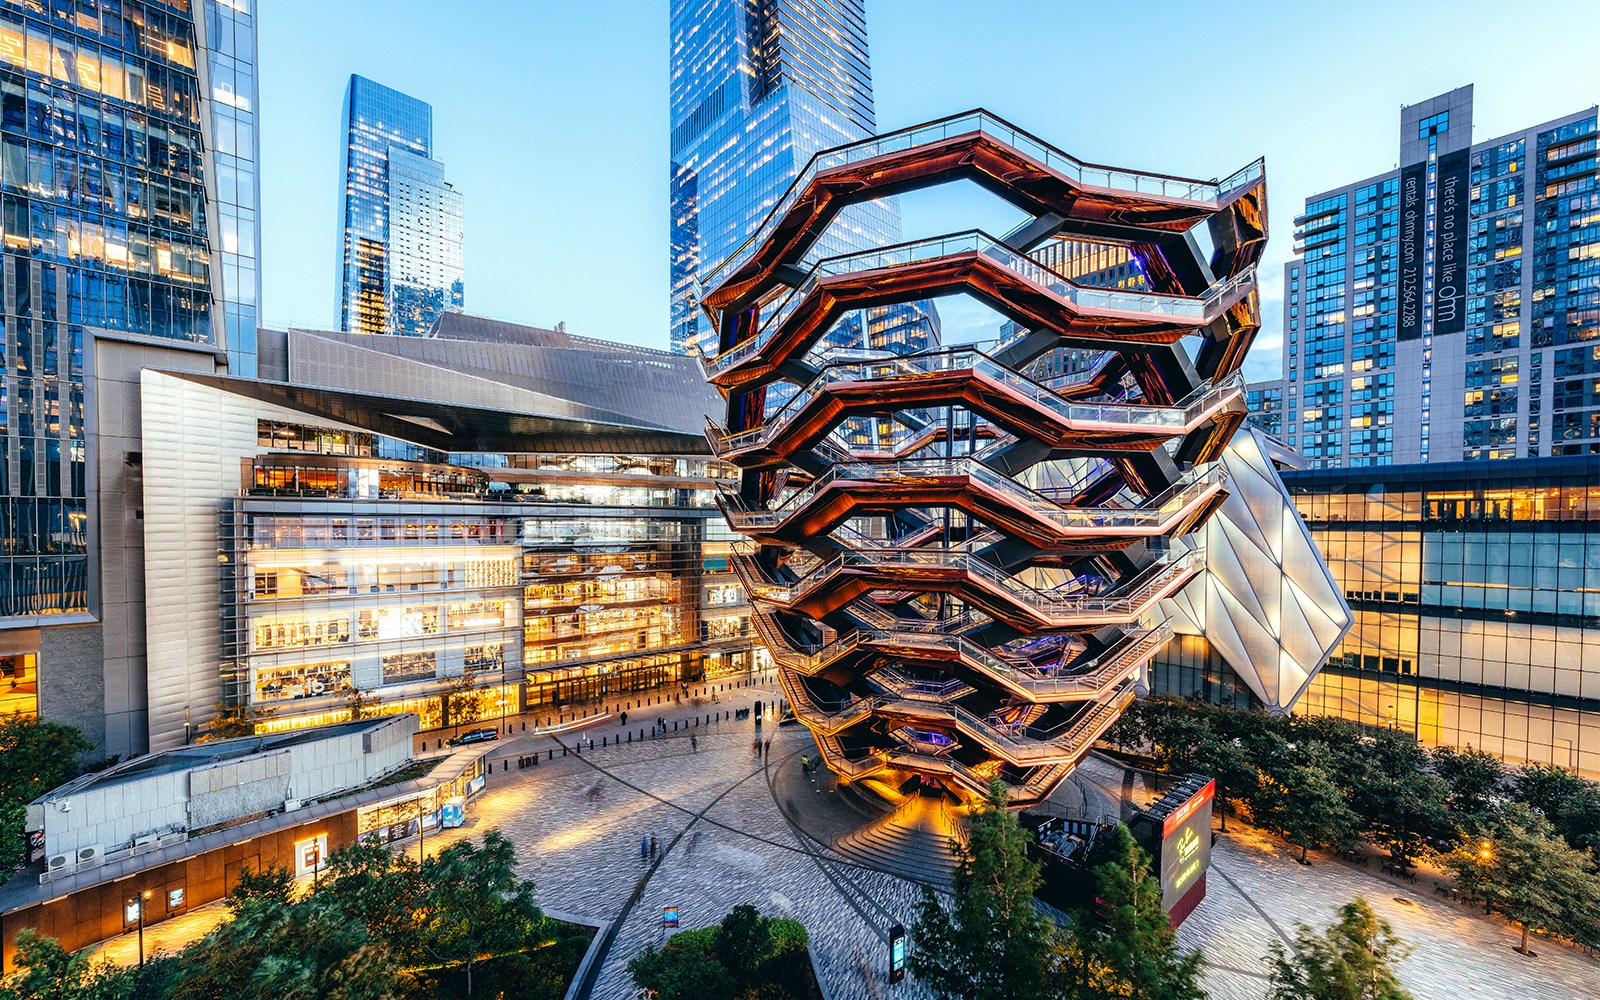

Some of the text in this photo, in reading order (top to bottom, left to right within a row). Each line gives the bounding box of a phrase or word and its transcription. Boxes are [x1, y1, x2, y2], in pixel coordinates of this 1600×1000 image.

[1402, 177, 1419, 328] rentals ohmny.com 212.564.2288
[1438, 176, 1464, 323] there's no place like ohm
